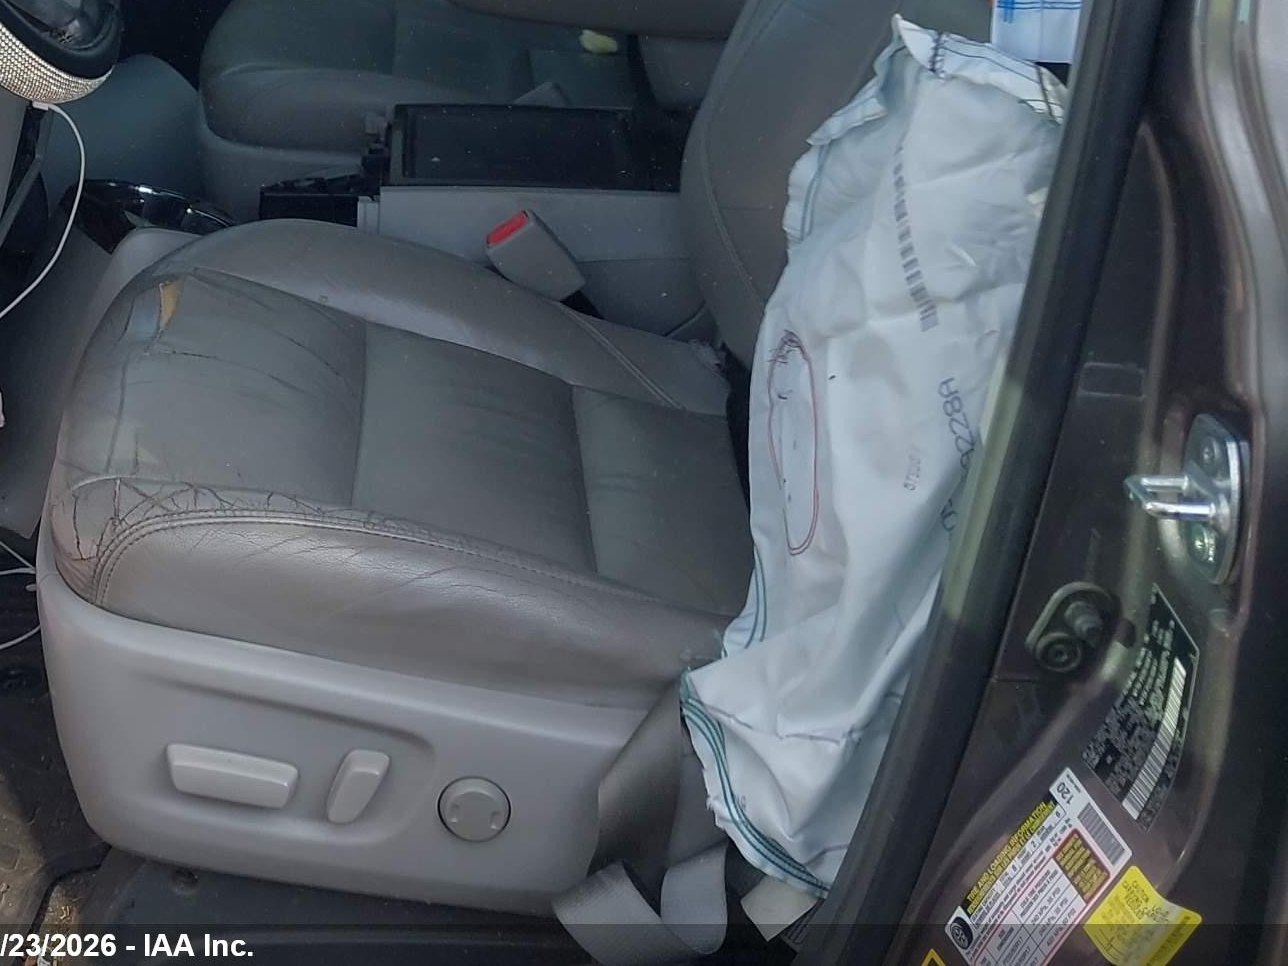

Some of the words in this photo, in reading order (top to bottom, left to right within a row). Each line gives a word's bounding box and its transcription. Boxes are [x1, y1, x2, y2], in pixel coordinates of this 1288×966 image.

[1057, 782, 1073, 804] 120
[966, 886, 979, 902] TIRE
[977, 872, 990, 889] AND
[988, 844, 1012, 874] LOADING
[1009, 801, 1047, 847] INFORMATION
